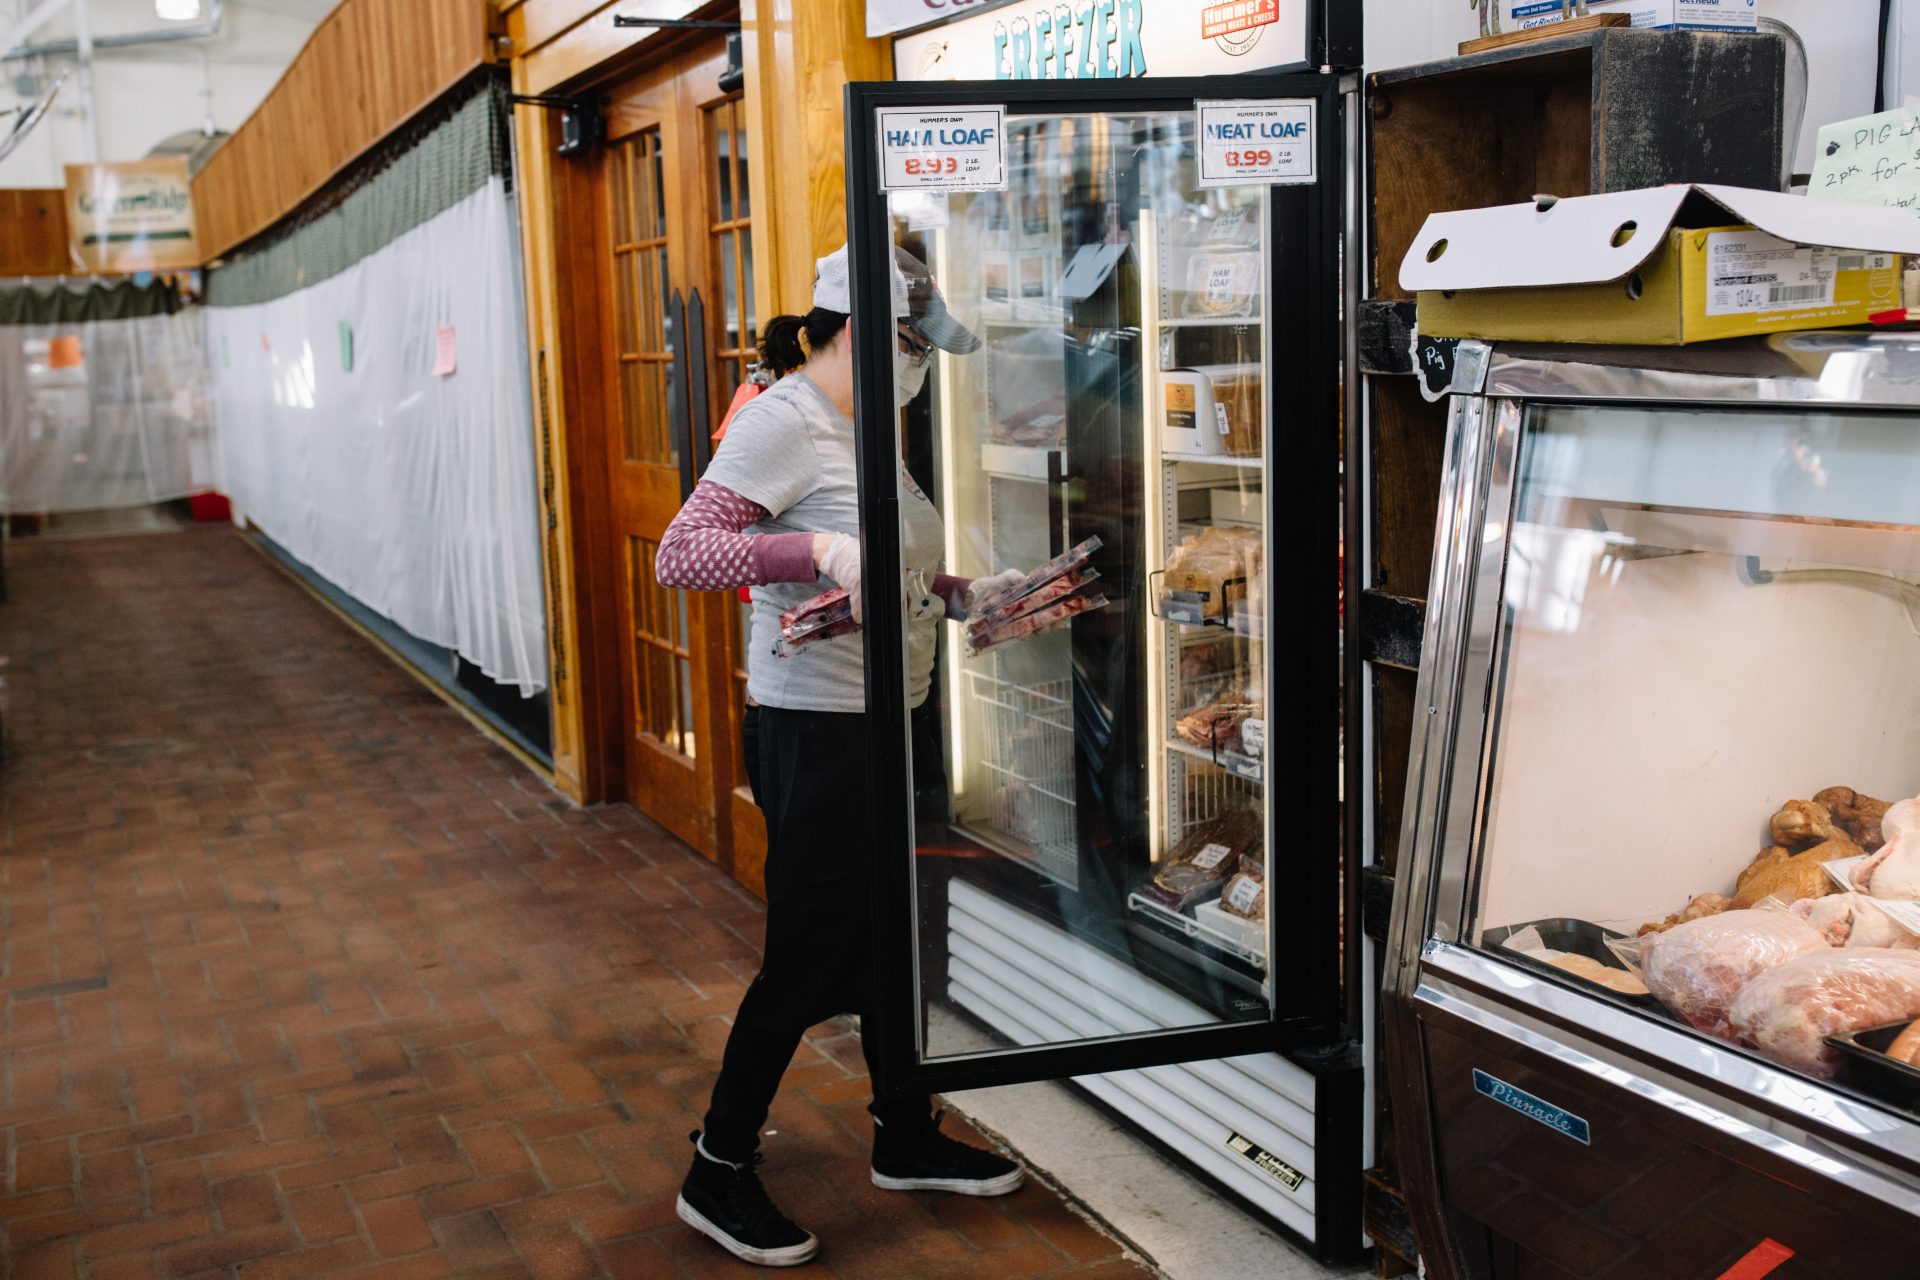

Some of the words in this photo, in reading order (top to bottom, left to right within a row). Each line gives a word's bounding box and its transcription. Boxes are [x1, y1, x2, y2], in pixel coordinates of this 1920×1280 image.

[1228, 17, 1247, 30] MEATS
[1253, 11, 1275, 24] CHEESE
[994, 0, 1147, 80] FREEZER
[940, 129, 994, 145] LOAF
[1207, 123, 1255, 139] MEAT
[1260, 122, 1306, 138] LOAF
[1854, 124, 1891, 150] PIG
[1225, 149, 1271, 166] 8.99
[1871, 157, 1907, 182] for
[1213, 269, 1230, 277] HAM
[1210, 279, 1229, 287] LOAF
[1425, 346, 1445, 370] Pig
[1490, 1081, 1571, 1131] Pinnacle
